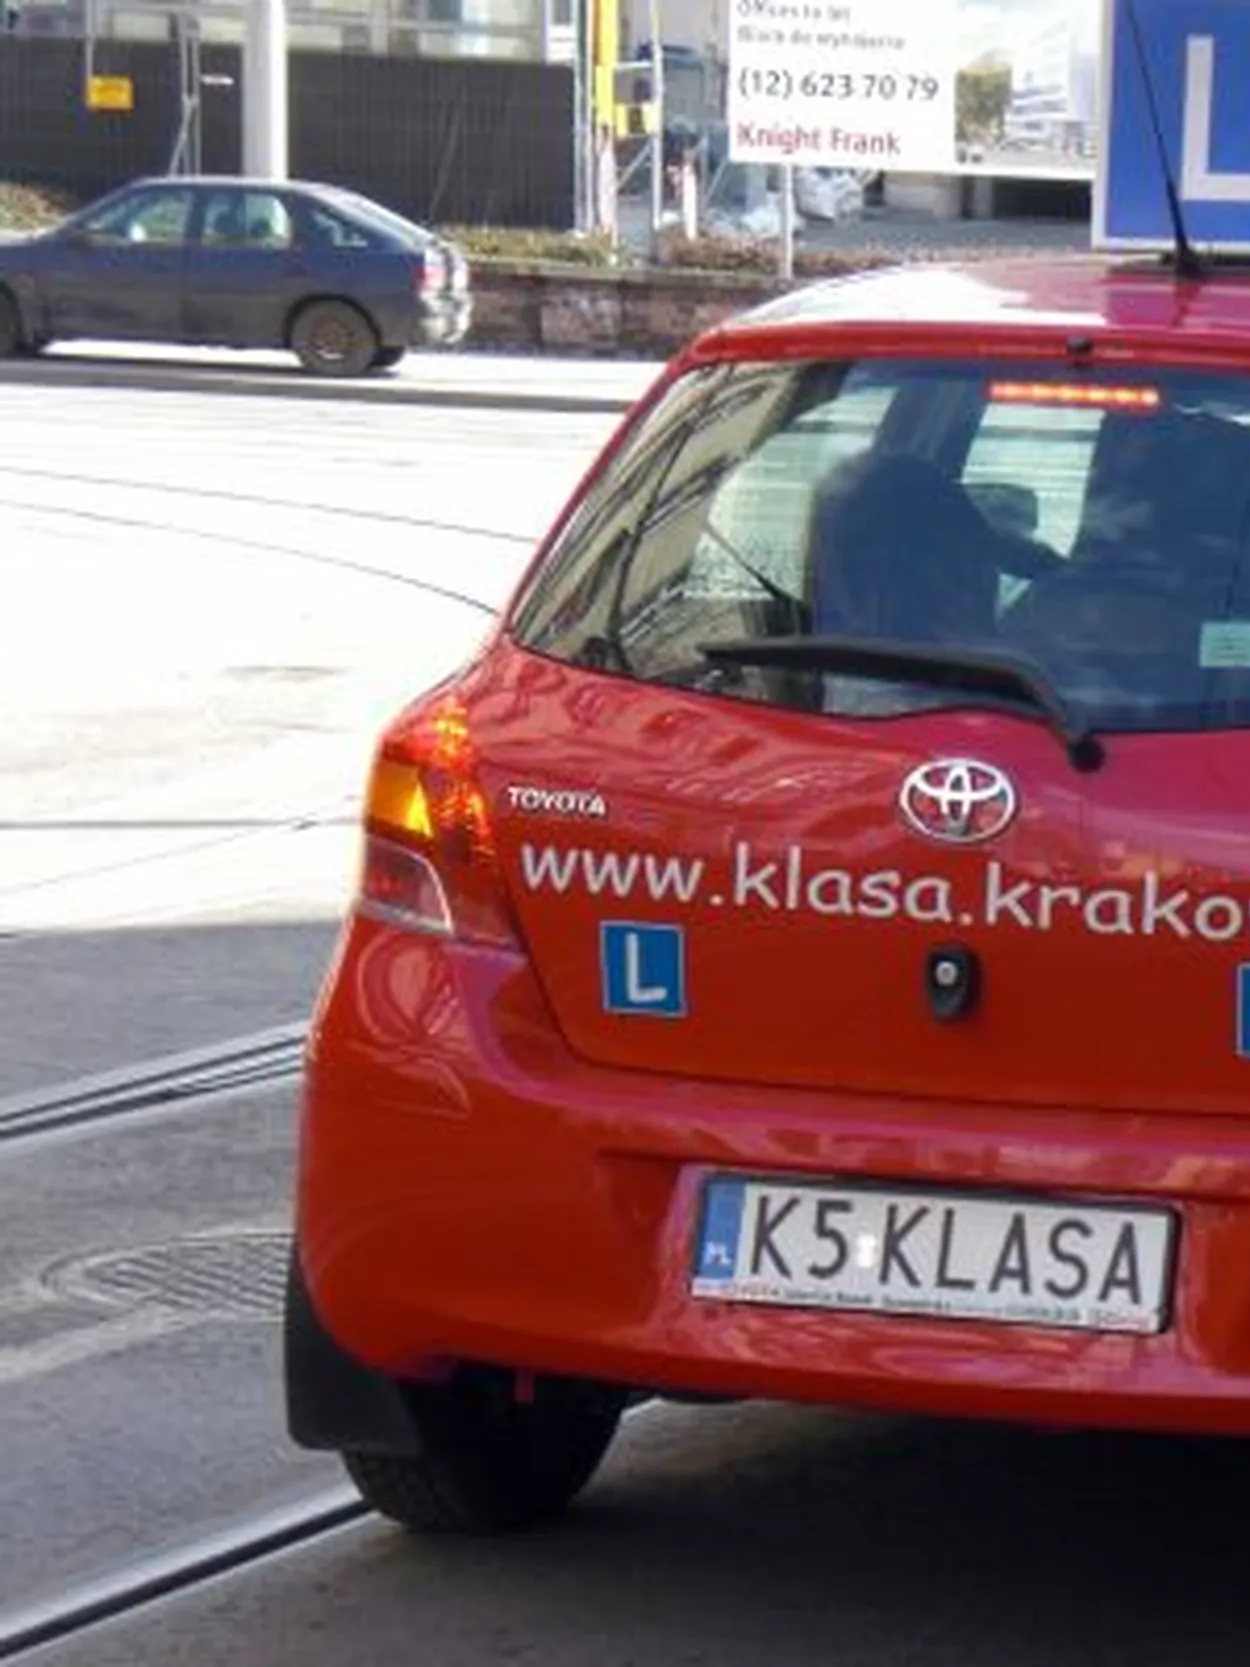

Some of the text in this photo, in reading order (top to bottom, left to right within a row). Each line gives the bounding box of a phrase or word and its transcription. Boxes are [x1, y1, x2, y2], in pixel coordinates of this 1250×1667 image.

[738, 67, 939, 101] (12) 623 70 79
[737, 121, 901, 155] Knight Frank
[507, 786, 605, 816] TOYOTA
[625, 932, 668, 1003] L
[750, 1194, 1141, 1304] K5 KLASA
